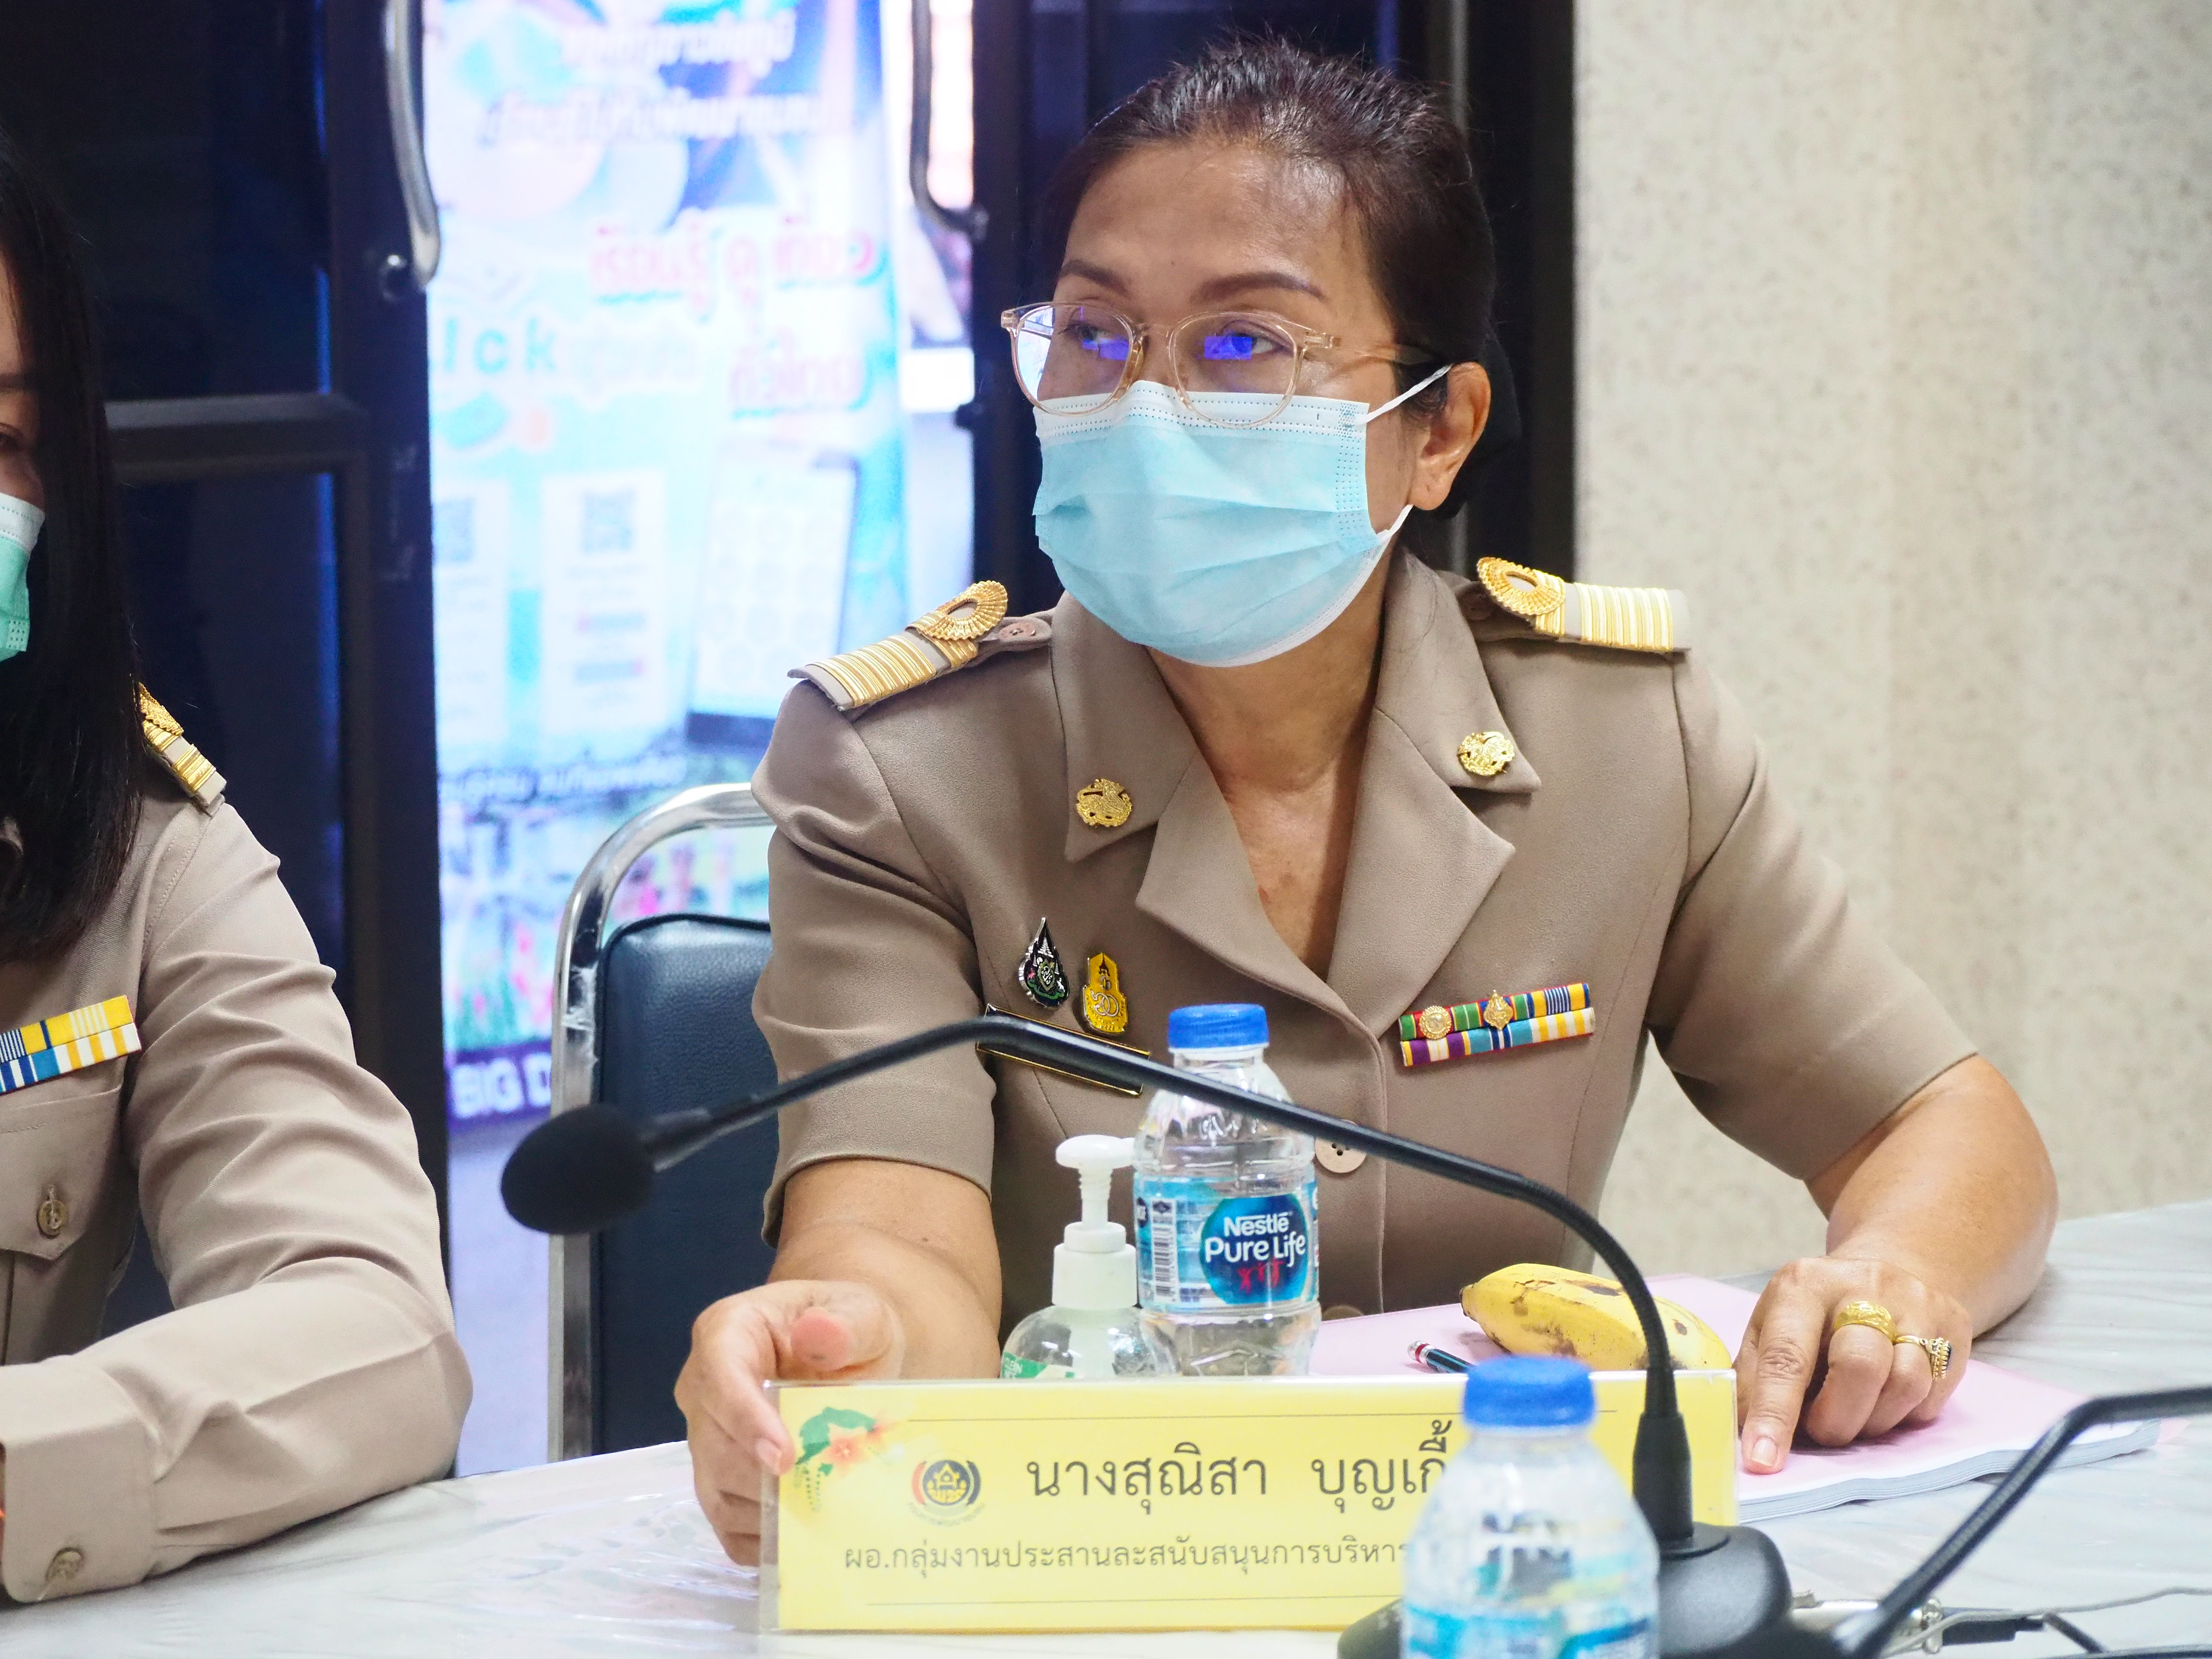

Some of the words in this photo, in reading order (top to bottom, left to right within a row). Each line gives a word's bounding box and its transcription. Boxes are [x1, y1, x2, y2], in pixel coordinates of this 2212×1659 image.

[1204, 1236, 1270, 1263] Pure
[1273, 1231, 1306, 1267] Life
[1026, 1441, 1267, 1515] นางสุณิสา
